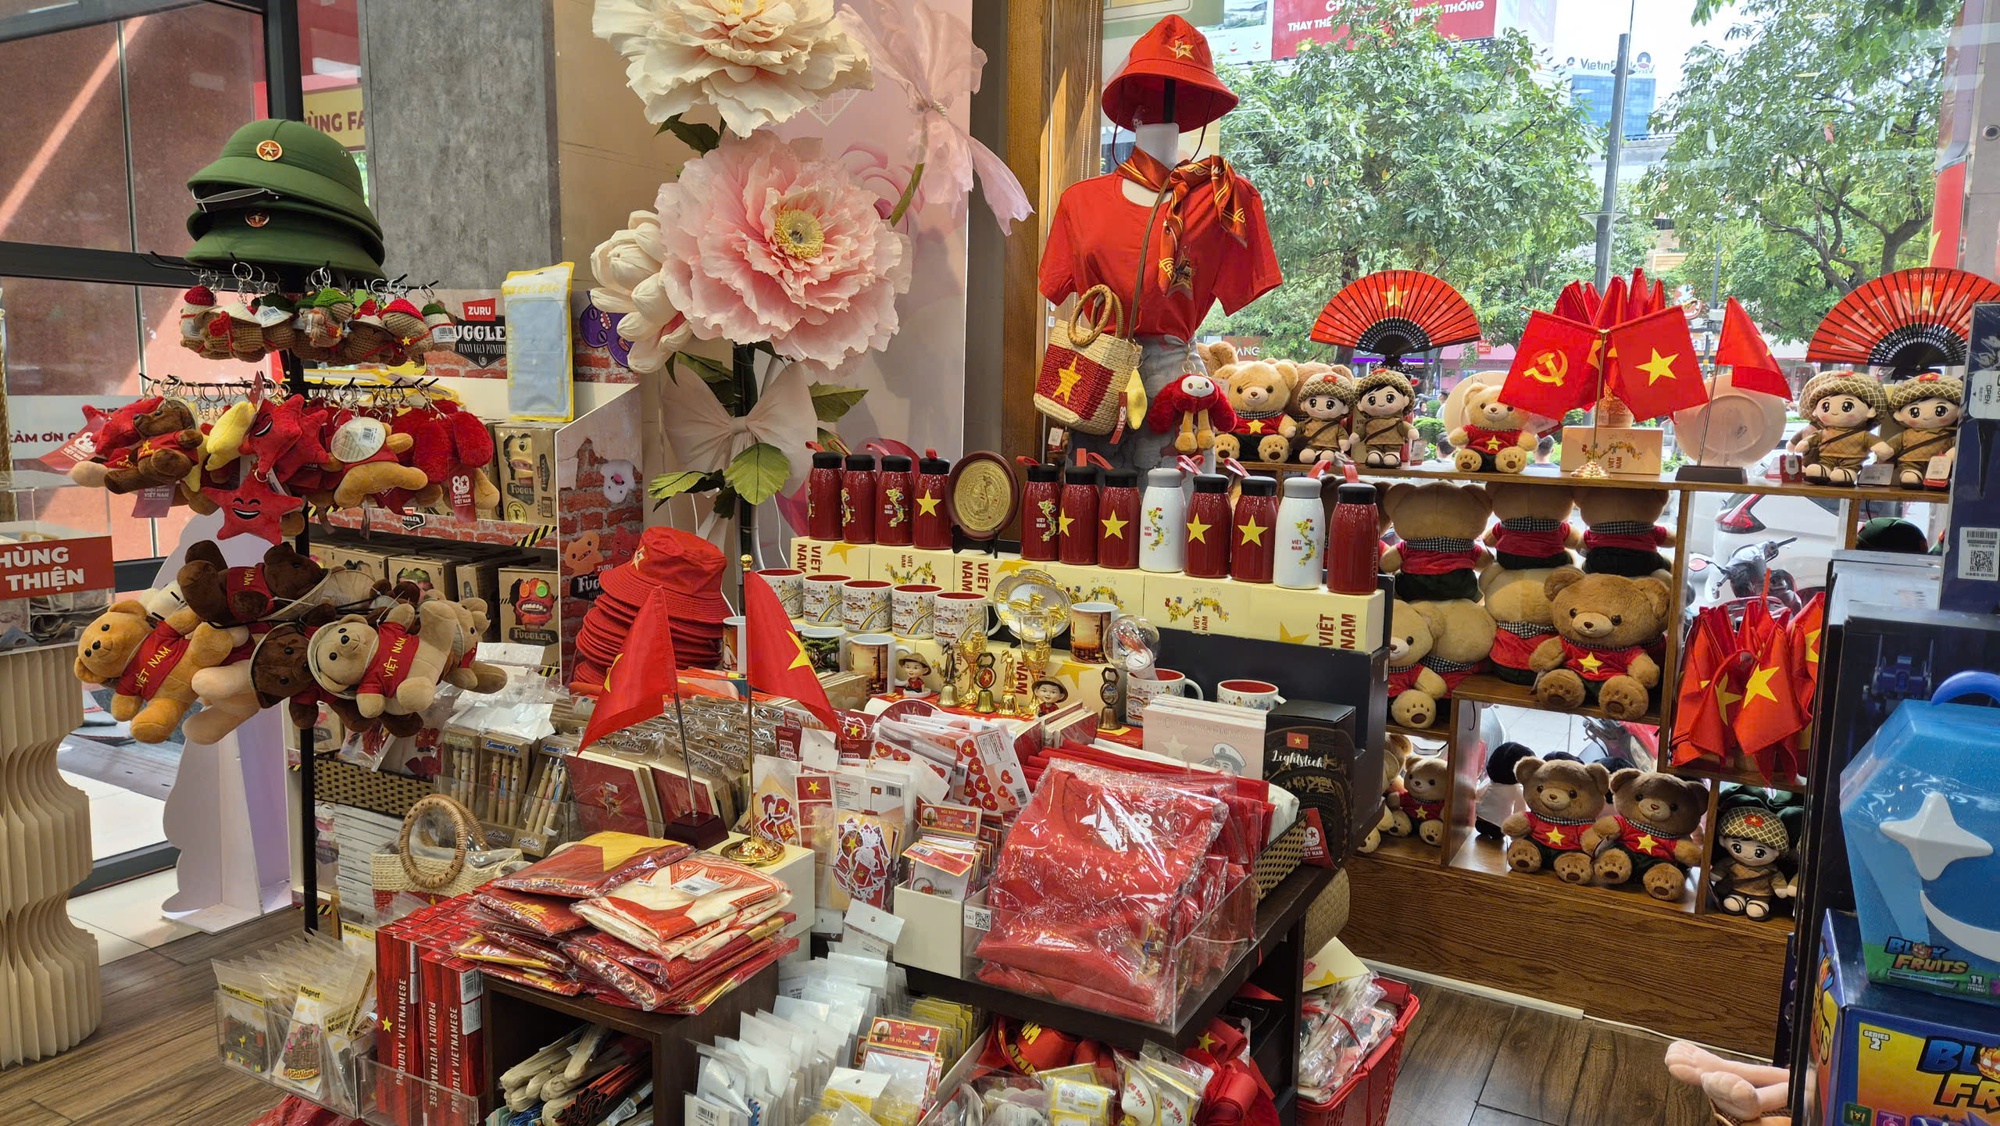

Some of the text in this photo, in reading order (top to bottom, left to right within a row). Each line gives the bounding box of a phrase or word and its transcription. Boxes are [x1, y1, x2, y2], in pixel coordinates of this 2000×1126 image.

[1287, 20, 1313, 31] THAY
[1444, 0, 1485, 15] THỐNG
[305, 110, 343, 132] ÙNG
[467, 306, 492, 316] ZURU
[454, 325, 506, 342] UGGLE
[1984, 384, 1993, 405] OPEN
[42, 431, 64, 443] ƠN
[5, 565, 85, 591] THIỆN
[961, 560, 991, 592] VIỆT NAM
[1316, 613, 1357, 650] VIỆT NAM
[135, 645, 172, 688] VIỆT NAM
[382, 656, 399, 678] VIỆT
[1016, 661, 1029, 695] NAM
[1271, 749, 1325, 768] Lightstick
[1893, 954, 1969, 975] FRUITS
[300, 985, 321, 999] Magnet
[396, 978, 407, 1086] PROUDLY VIETNAMESE
[428, 1001, 438, 1045] PROUDLY
[1863, 1029, 1890, 1041] SERIES
[1869, 1037, 1882, 1051] 2
[450, 1006, 461, 1114] PROUDLY VIETNAMESE
